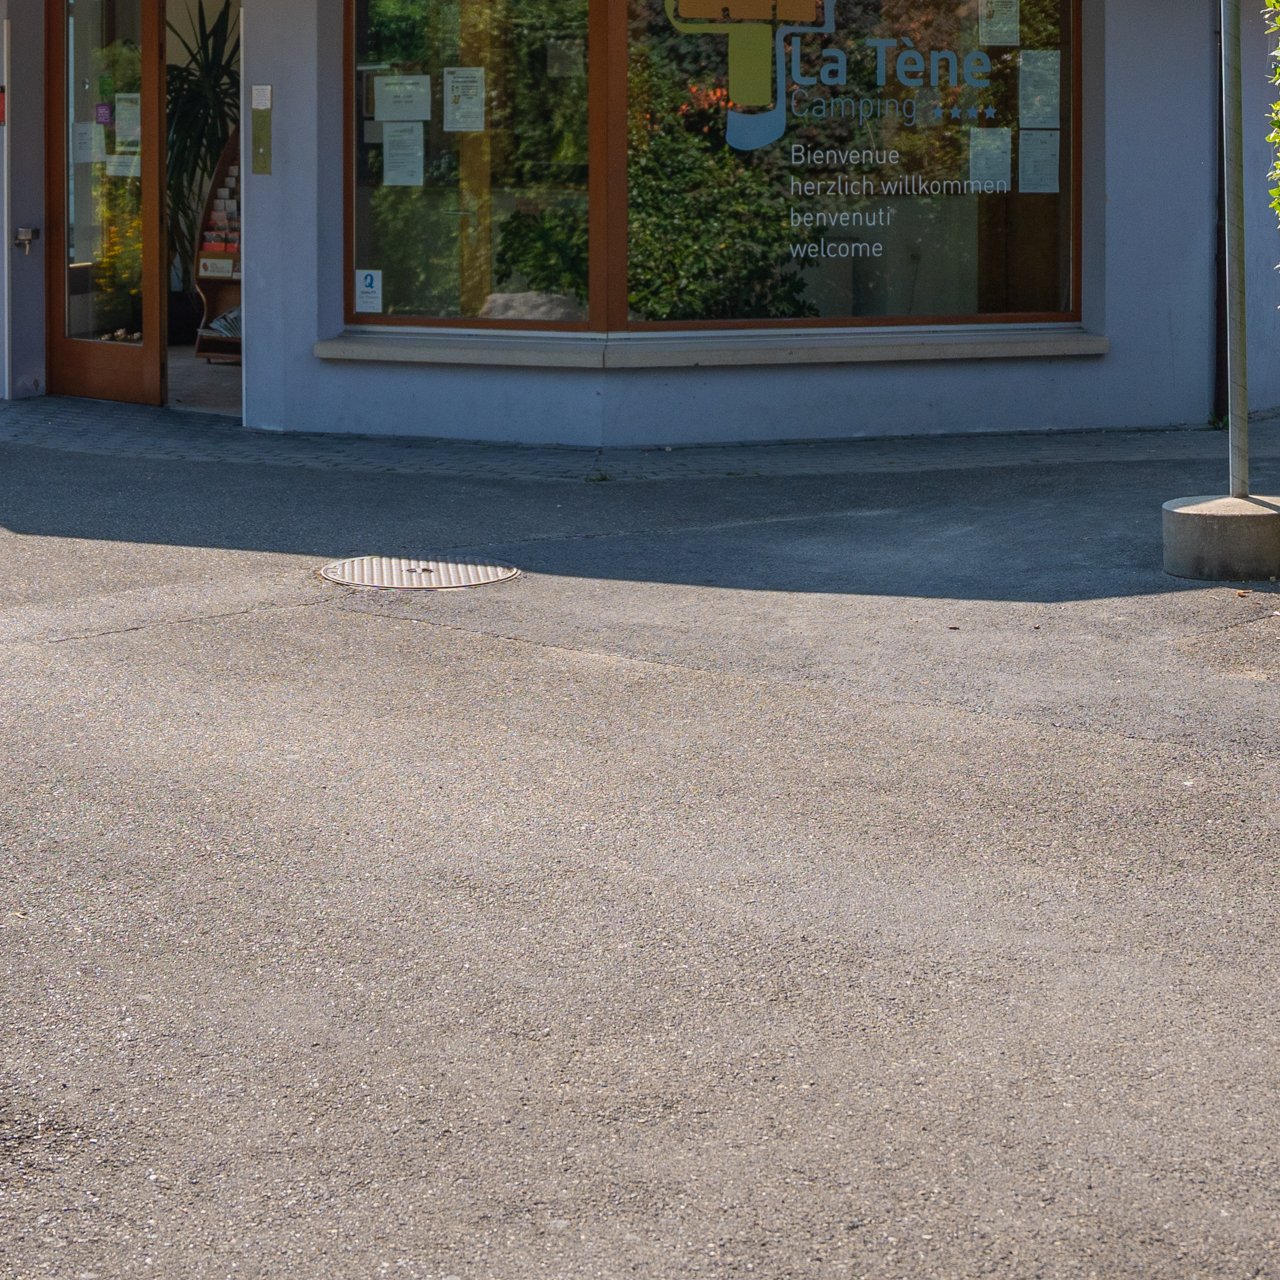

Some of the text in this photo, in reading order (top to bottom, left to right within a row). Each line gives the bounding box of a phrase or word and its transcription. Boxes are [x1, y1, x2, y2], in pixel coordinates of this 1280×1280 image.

[791, 36, 992, 87] La Tène
[791, 89, 917, 127] Camping
[790, 144, 900, 165] Bienvenue
[790, 175, 1008, 196] herzlich willkommen
[790, 207, 891, 227] benvenuti
[790, 237, 884, 258] welcome
